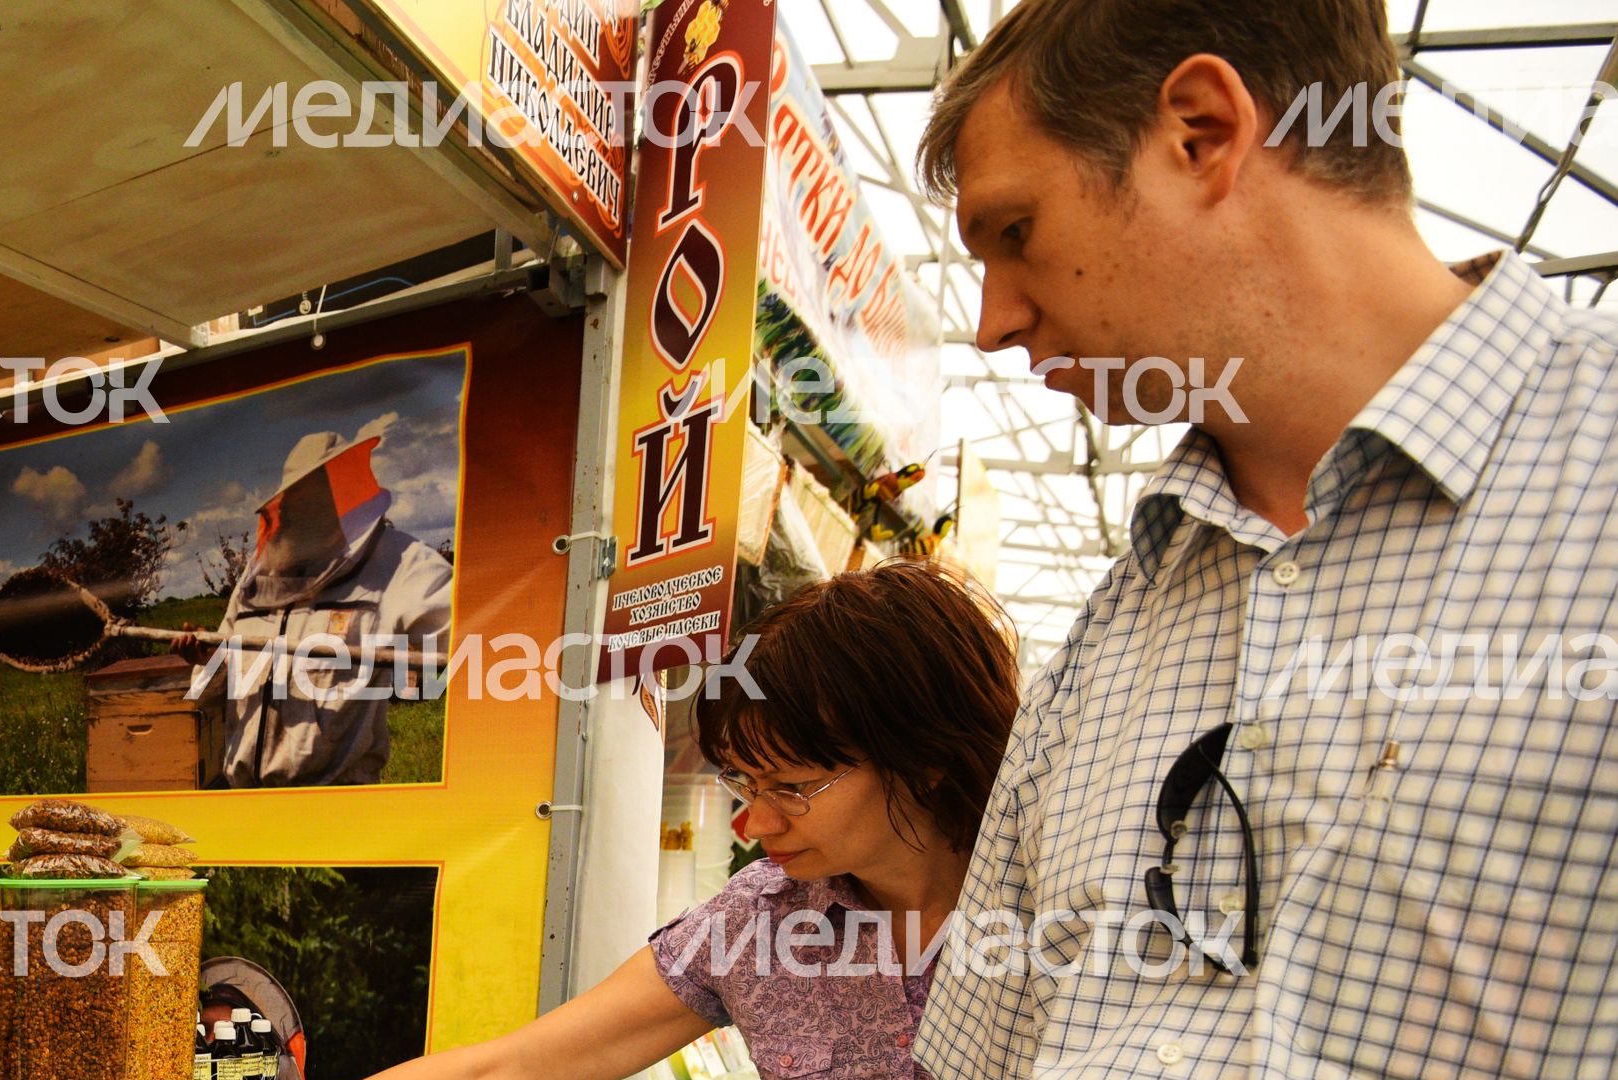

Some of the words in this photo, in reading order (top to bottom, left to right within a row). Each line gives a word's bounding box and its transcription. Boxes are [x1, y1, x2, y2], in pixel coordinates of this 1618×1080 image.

[614, 567, 722, 609] ПЧЕЛОВОДЧЕСКОЕ
[631, 592, 700, 624] ХОЗЯЙСТВО
[666, 612, 719, 638] ПАСЕКИ
